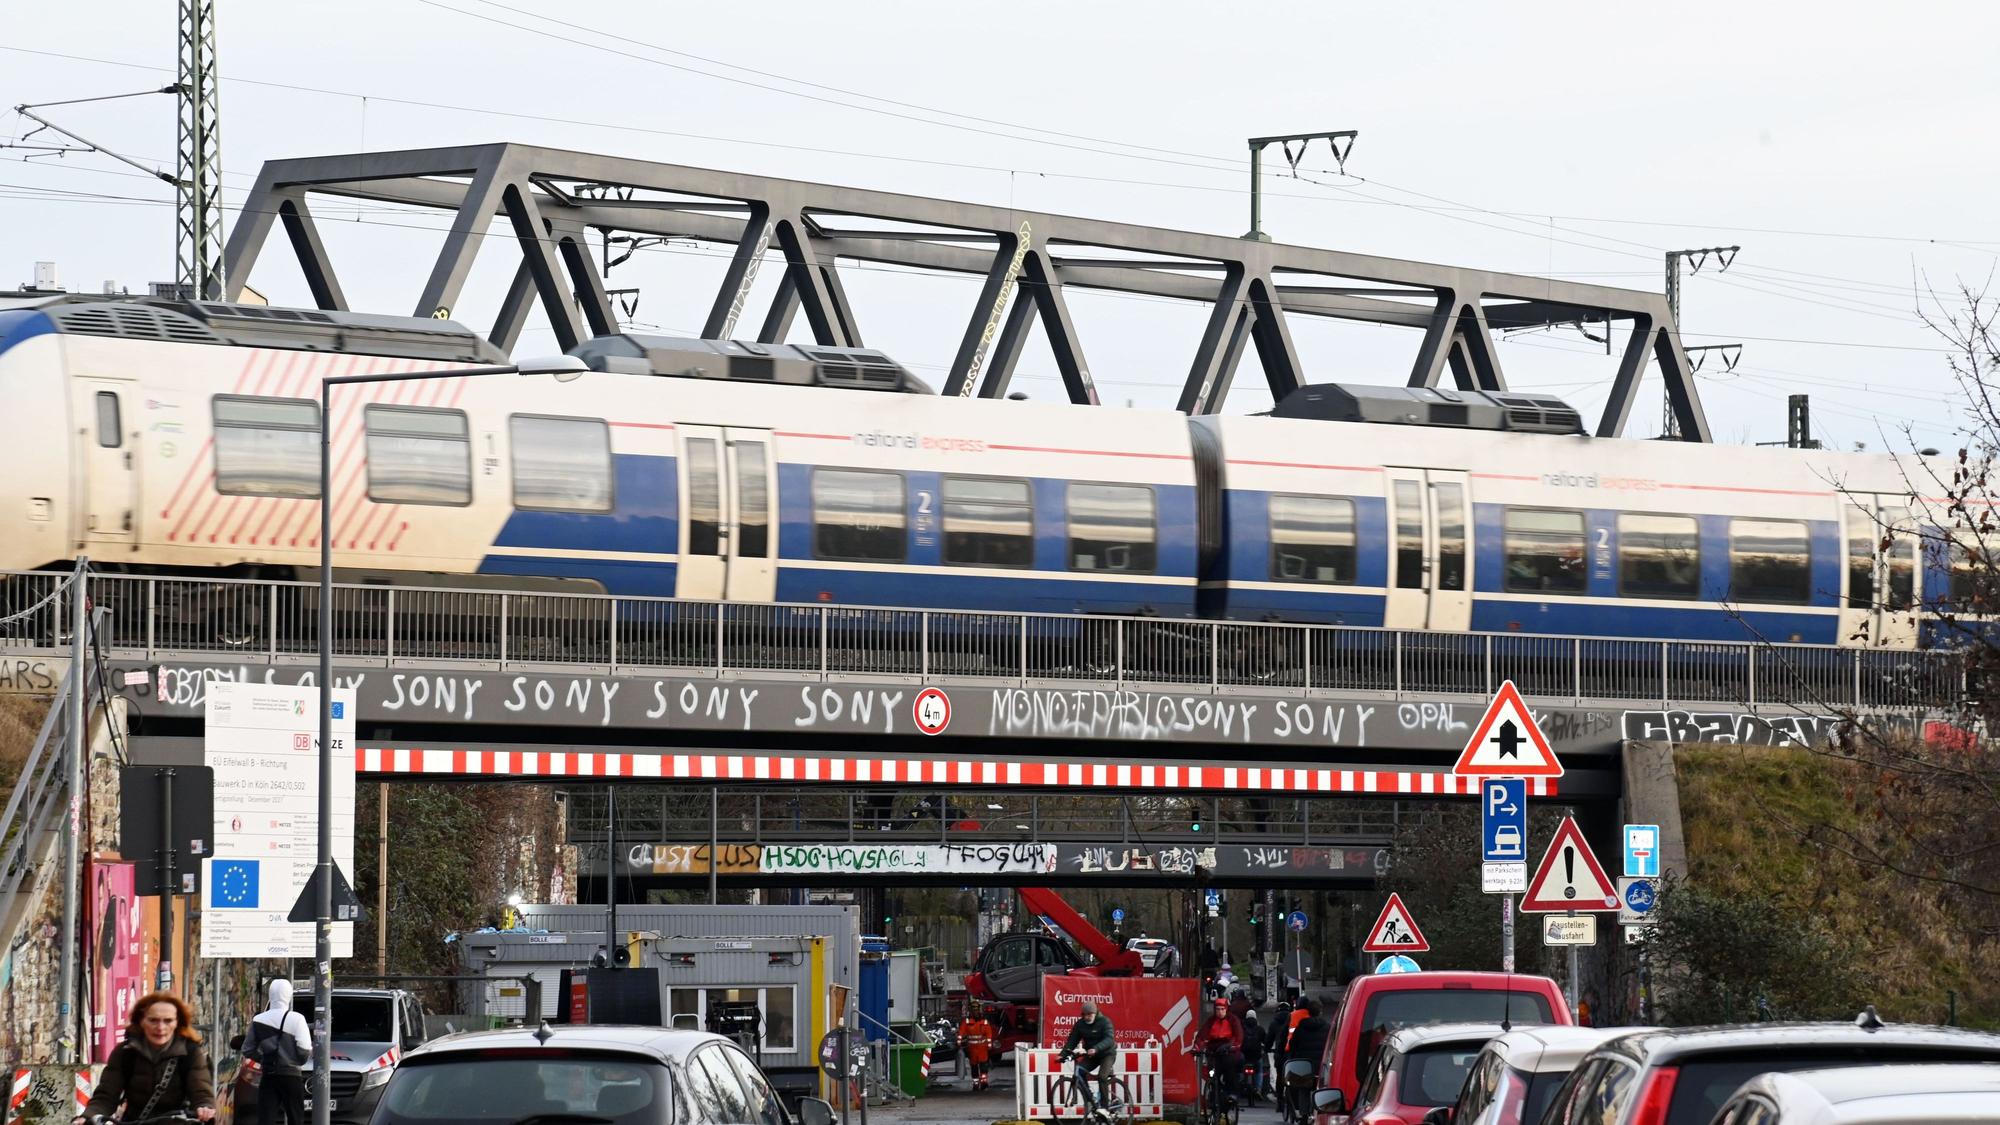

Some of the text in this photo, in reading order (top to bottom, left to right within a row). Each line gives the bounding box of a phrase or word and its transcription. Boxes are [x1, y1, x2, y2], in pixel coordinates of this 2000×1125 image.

[917, 491, 932, 514] 2
[1596, 528, 1609, 548] 2
[382, 674, 482, 719] SONY
[504, 676, 620, 725] SONY
[647, 681, 759, 730] SONY
[795, 686, 903, 733] SONY
[924, 702, 941, 720] 4 m
[1174, 697, 1257, 743] SONY
[1399, 702, 1469, 731] OPAL
[1273, 701, 1376, 747] SONY
[295, 736, 309, 748] DB
[260, 759, 288, 771] Richtung
[1489, 784, 1509, 816] P
[694, 843, 766, 868] CUST
[1495, 866, 1522, 874] Parkschein
[1559, 931, 1584, 940] usfahrt
[1115, 1030, 1124, 1038] 24
